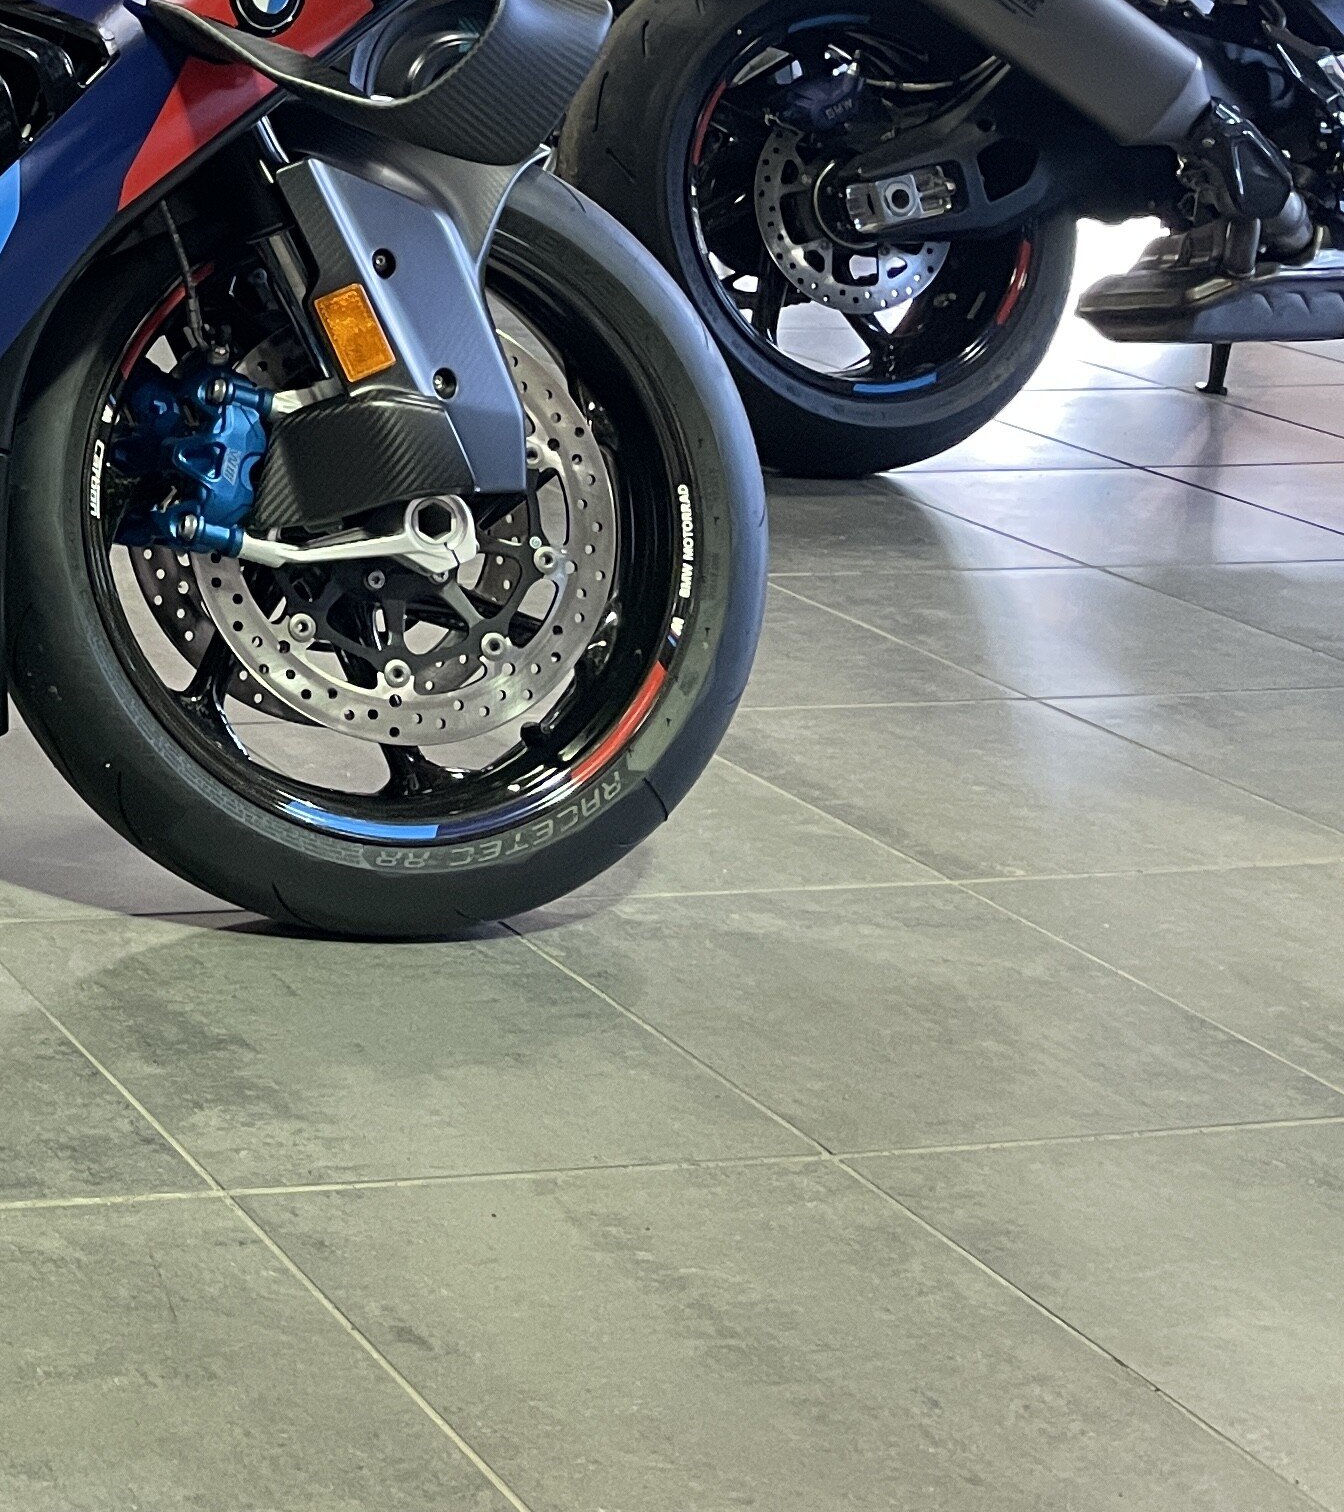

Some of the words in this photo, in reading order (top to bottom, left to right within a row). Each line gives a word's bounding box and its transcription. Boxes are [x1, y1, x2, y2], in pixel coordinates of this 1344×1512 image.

[90, 439, 105, 520] Carbon
[677, 484, 694, 561] MOTORRAD
[678, 562, 694, 599] BMW
[448, 770, 623, 868] RACETEC
[374, 849, 432, 869] RR
